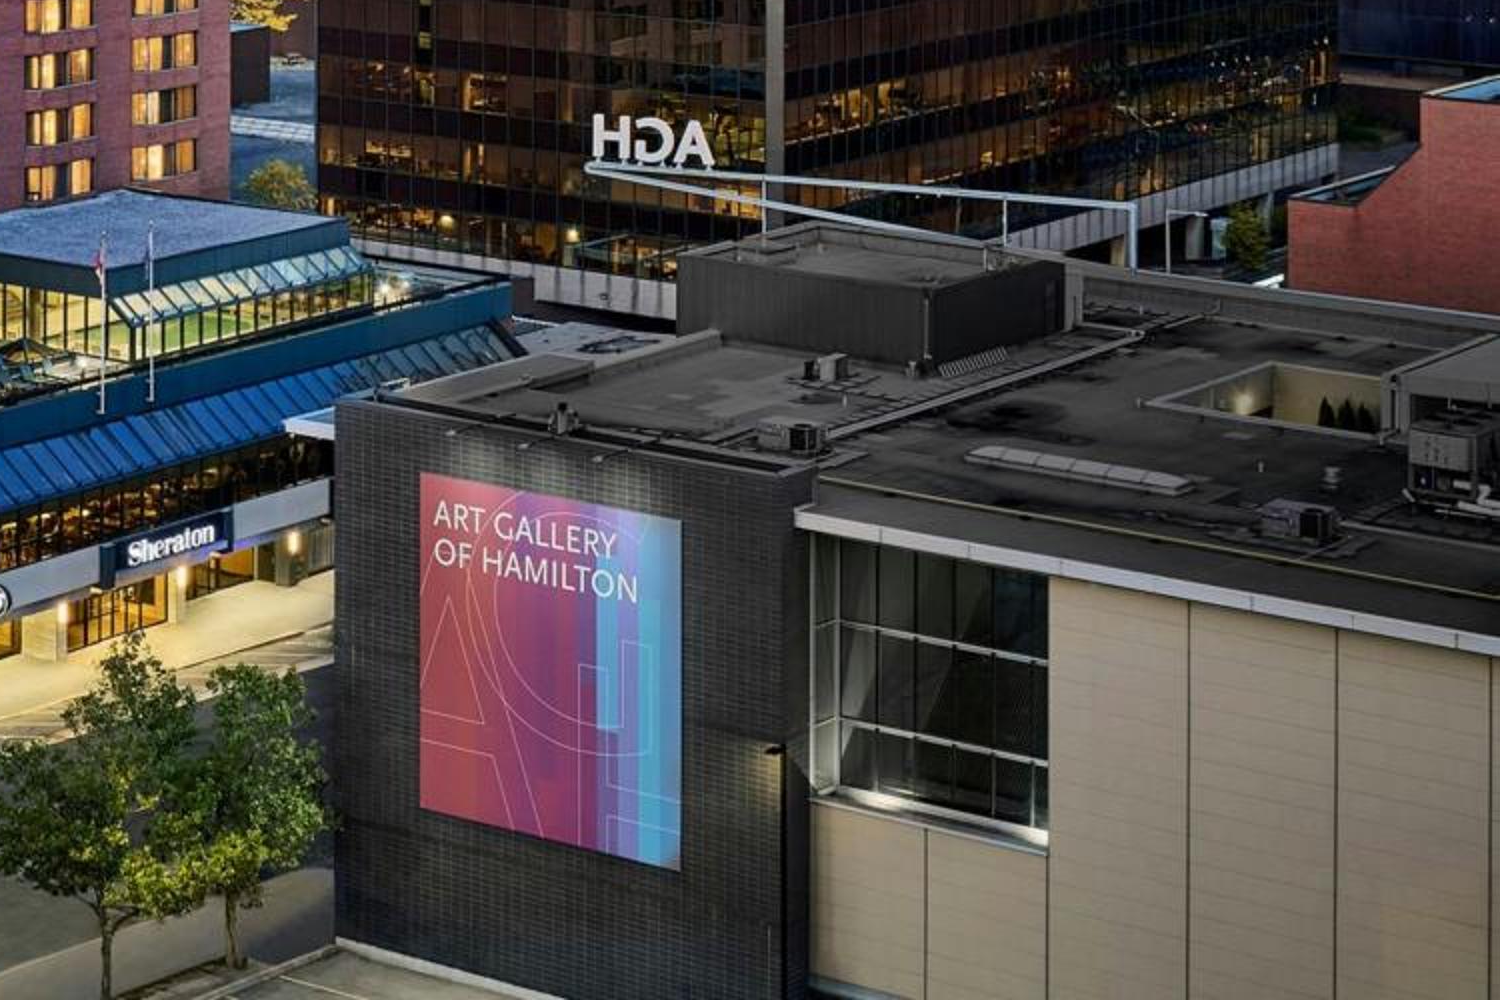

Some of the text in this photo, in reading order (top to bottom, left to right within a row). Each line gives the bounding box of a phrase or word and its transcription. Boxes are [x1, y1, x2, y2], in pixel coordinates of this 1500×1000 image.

[127, 525, 215, 567] Sheraton
[433, 500, 617, 560] ART GALLERY
[433, 538, 638, 603] OF HAMILTON
